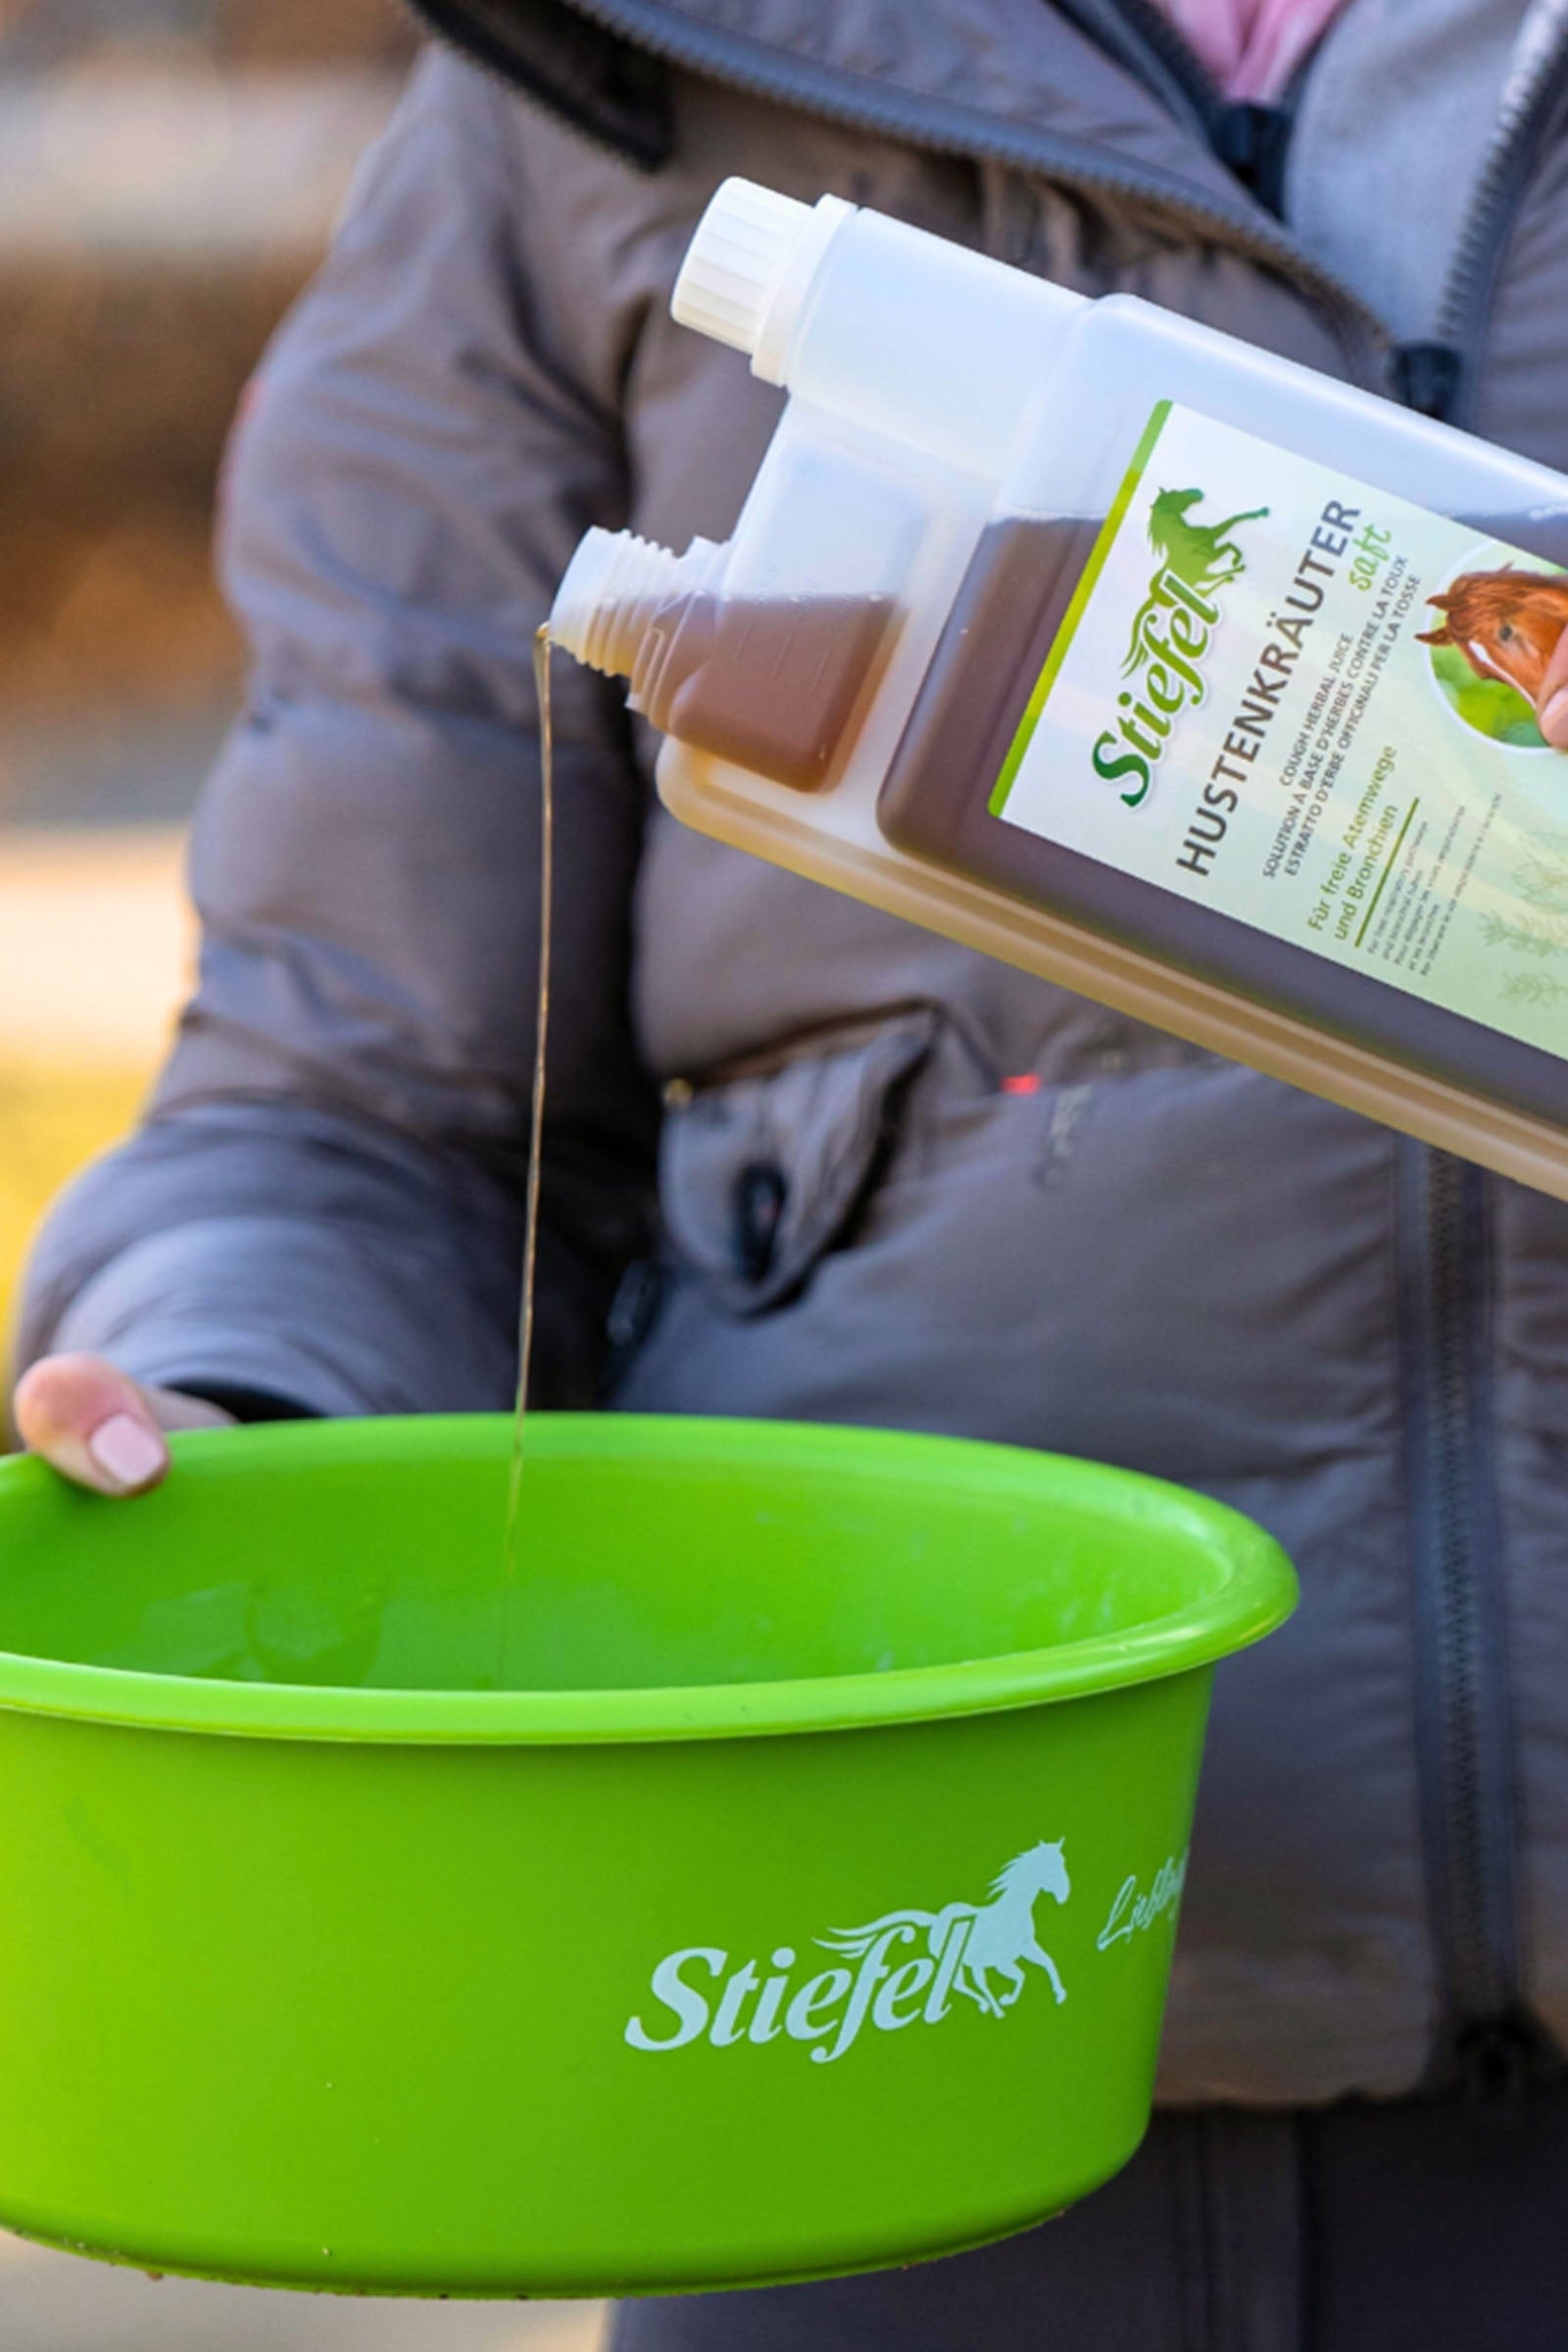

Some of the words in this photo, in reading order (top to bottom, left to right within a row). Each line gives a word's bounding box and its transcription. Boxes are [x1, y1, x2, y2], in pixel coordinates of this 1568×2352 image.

[1348, 523, 1392, 592] saft
[1392, 575, 1421, 618] TOSSE
[1092, 568, 1218, 808] Stiefel
[1175, 501, 1360, 877] HUSTENKRÄUTER
[1370, 643, 1392, 670] PER
[1384, 622, 1401, 642] LA
[1262, 806, 1300, 879] SOLUTION
[1298, 753, 1324, 790] BASE
[1315, 682, 1353, 752] D'HERBES
[1348, 620, 1381, 679] CONTRE
[1372, 601, 1390, 620] LA
[1381, 556, 1407, 596] TOUX
[1279, 731, 1310, 787] COUGH
[1303, 677, 1336, 731] HERBAL
[1329, 632, 1354, 673] JUICE
[1284, 804, 1322, 876] ESTRATTO
[1306, 901, 1331, 931] Für
[1320, 853, 1352, 895] freie
[1342, 746, 1396, 850] Atemwege
[1314, 753, 1345, 803] D'ERBE
[1334, 902, 1357, 940] und
[1346, 806, 1398, 901] Bronchien
[623, 1914, 975, 2065] Stiefel
